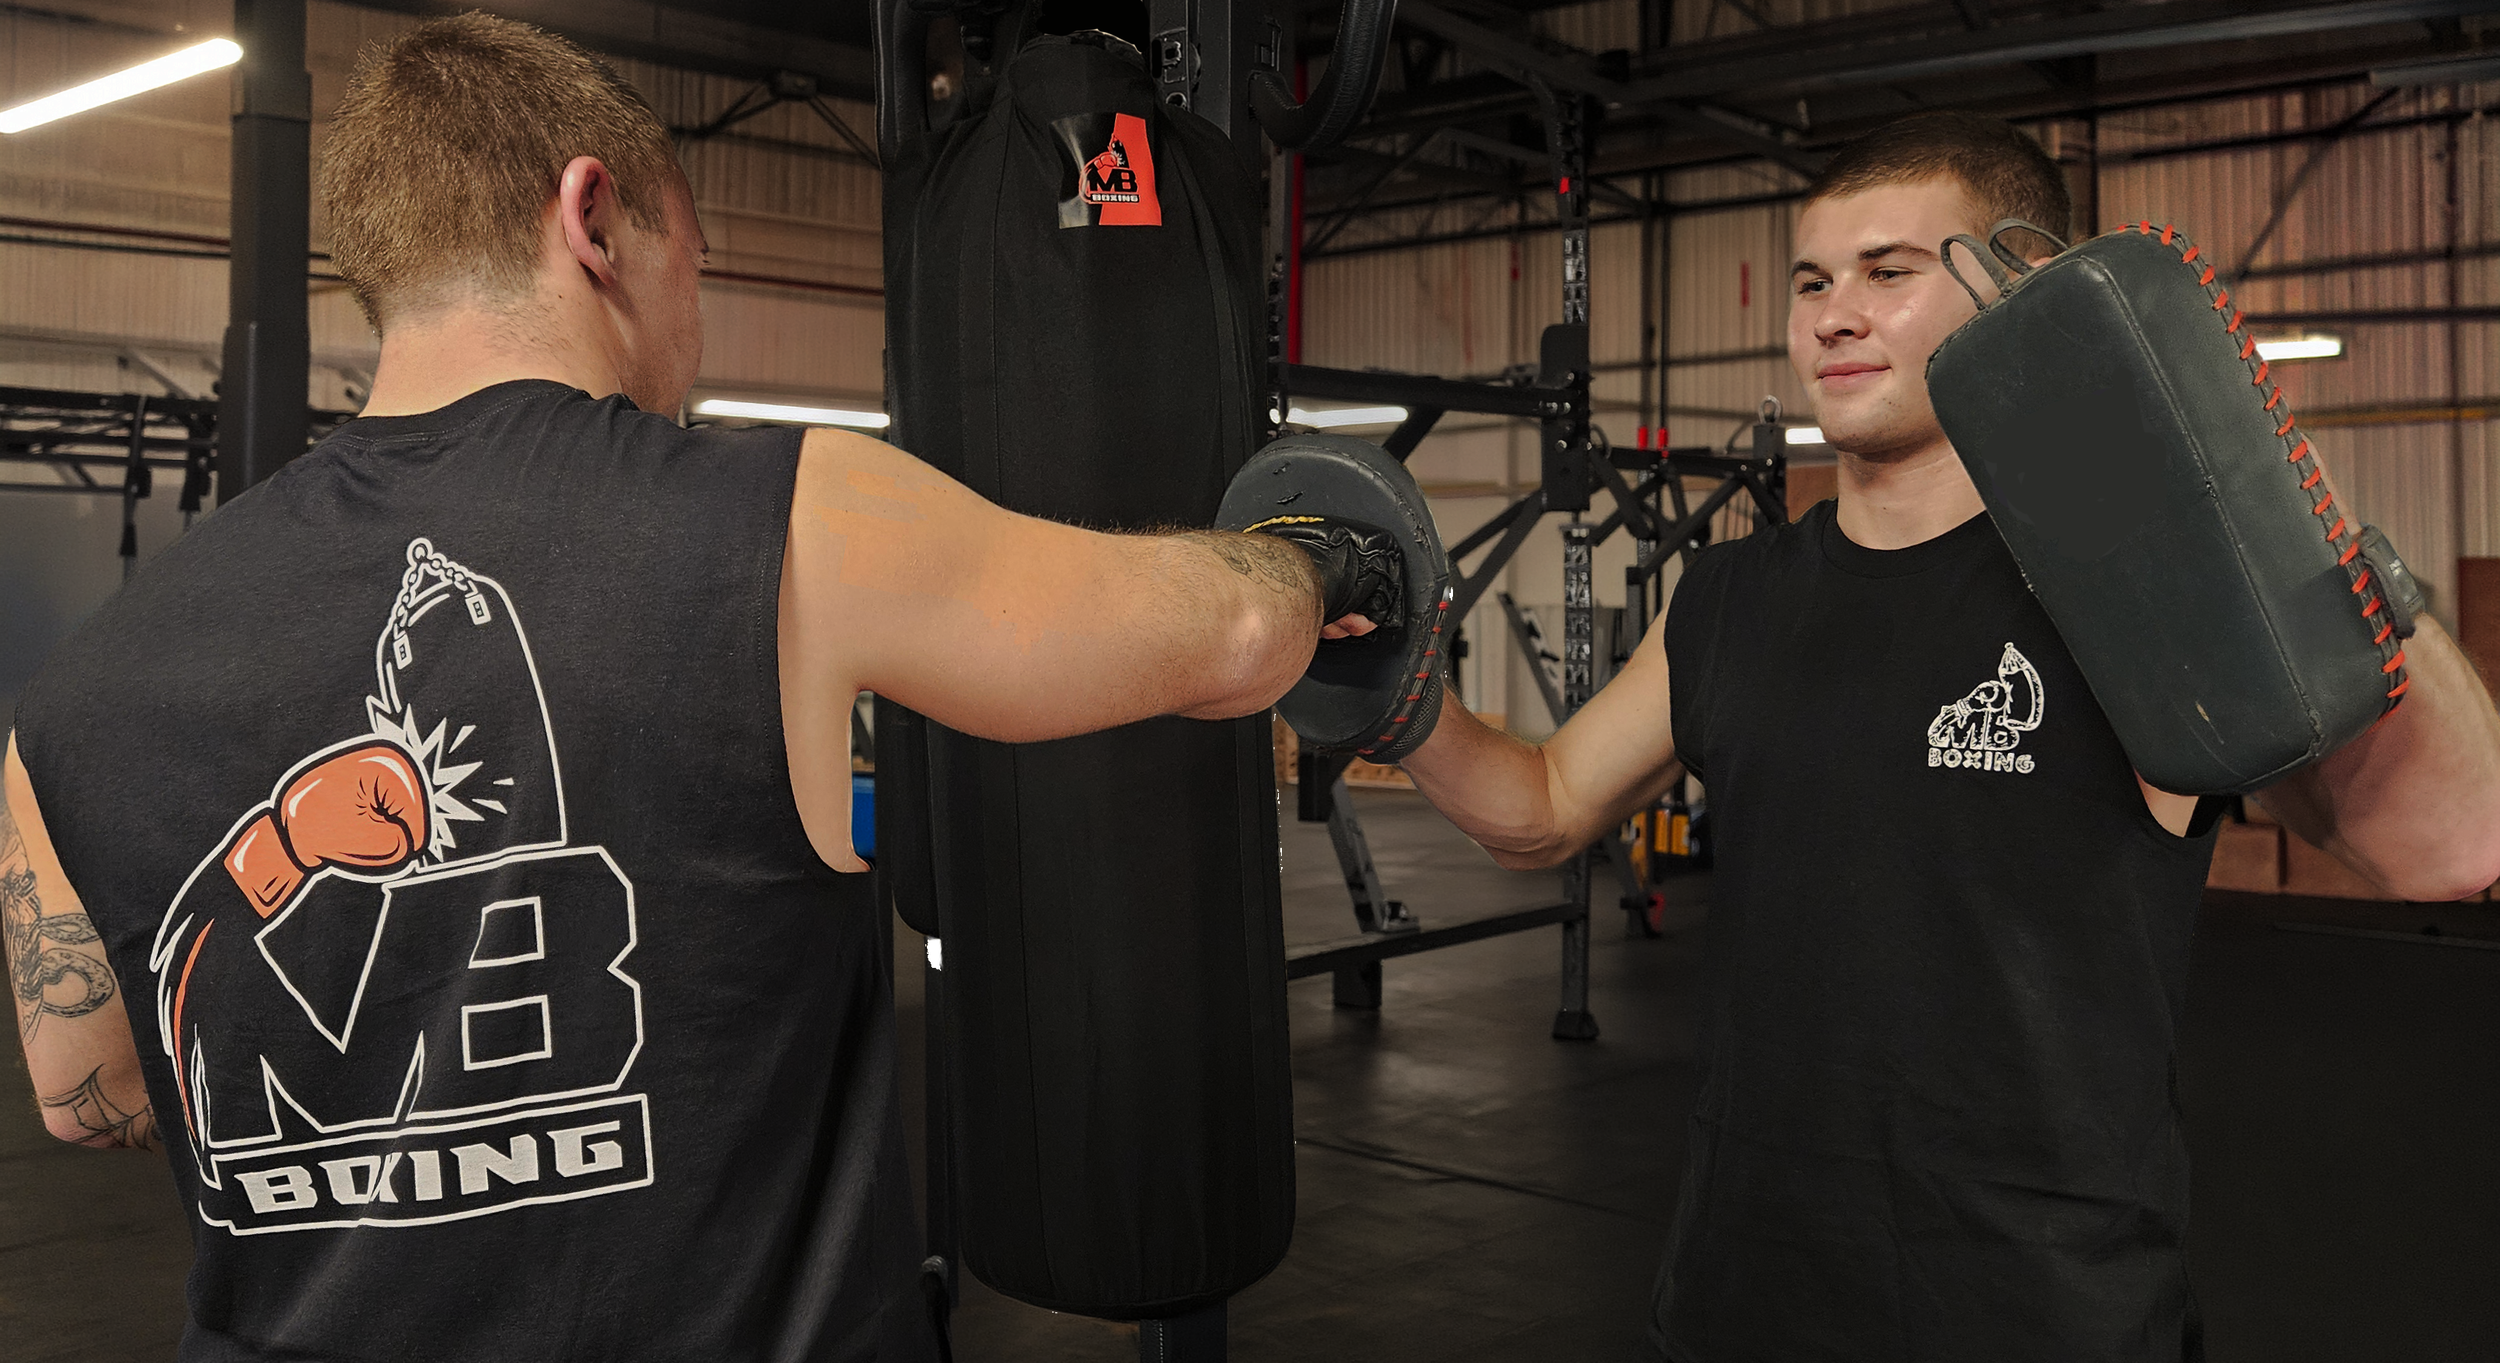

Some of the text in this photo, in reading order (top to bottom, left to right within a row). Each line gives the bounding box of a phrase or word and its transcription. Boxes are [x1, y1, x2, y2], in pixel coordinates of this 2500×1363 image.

[1086, 168, 1138, 192] MB
[1092, 194, 1139, 202] BOXING
[1929, 706, 2020, 751] MB
[1927, 747, 2036, 774] BOXING
[190, 846, 644, 1149] MB
